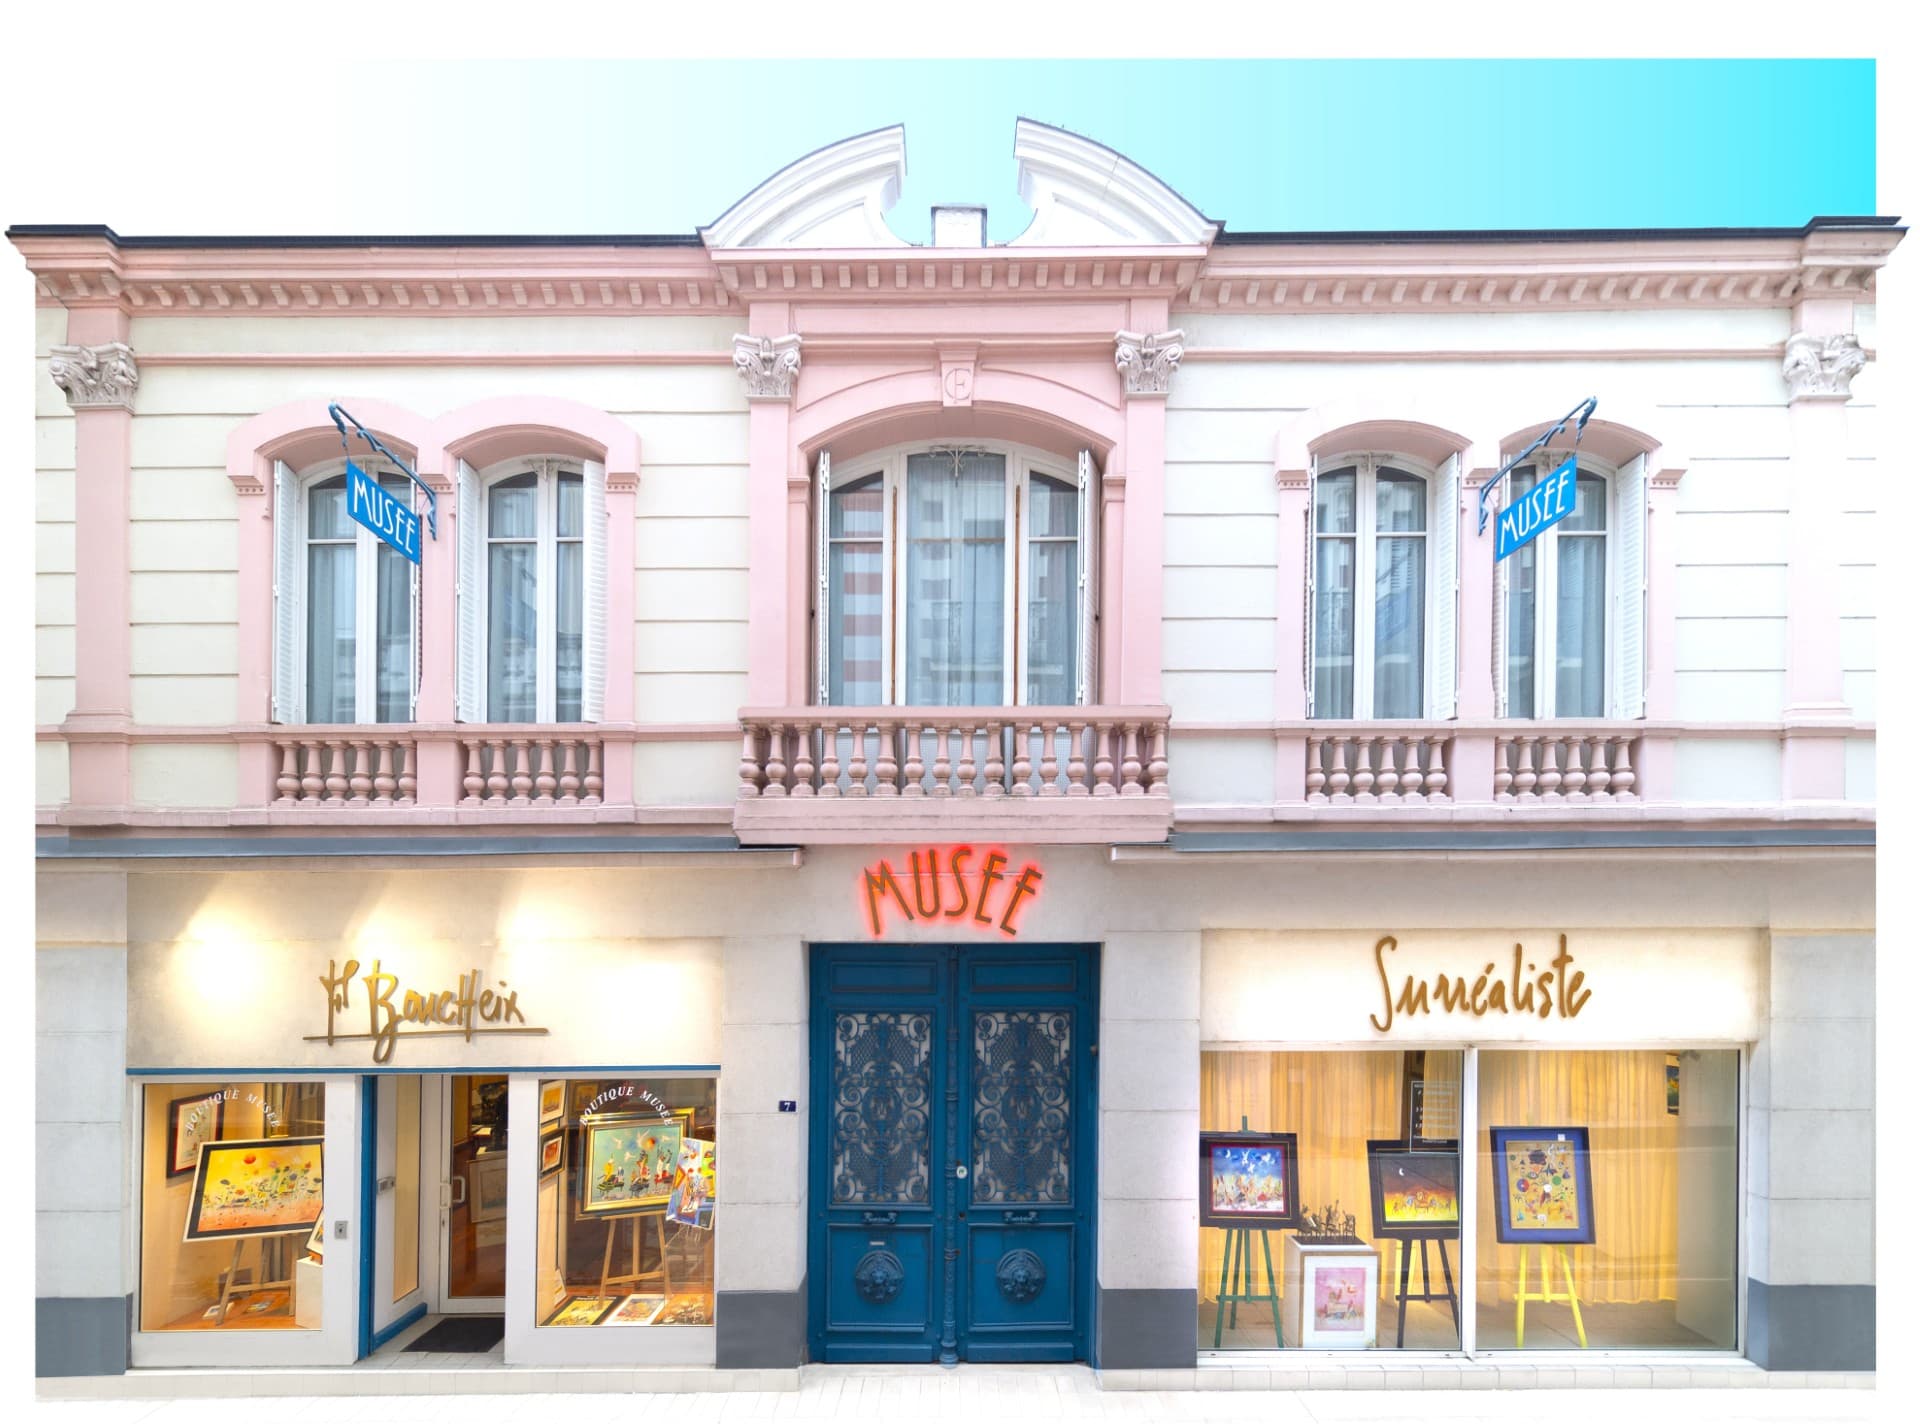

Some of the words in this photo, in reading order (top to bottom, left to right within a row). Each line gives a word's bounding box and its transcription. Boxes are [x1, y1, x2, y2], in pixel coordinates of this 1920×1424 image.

[353, 474, 416, 555] MUSEE
[1500, 469, 1570, 555] MUSEE
[864, 848, 1043, 935] MUSEE
[1369, 933, 1593, 1032] Surréaliste
[185, 1089, 240, 1132] BOUTIQUE
[246, 1093, 282, 1128] MUSEE
[579, 1086, 635, 1127] BOUTIQUE
[640, 1090, 674, 1127] MUSEE
[784, 1102, 791, 1111] 7
